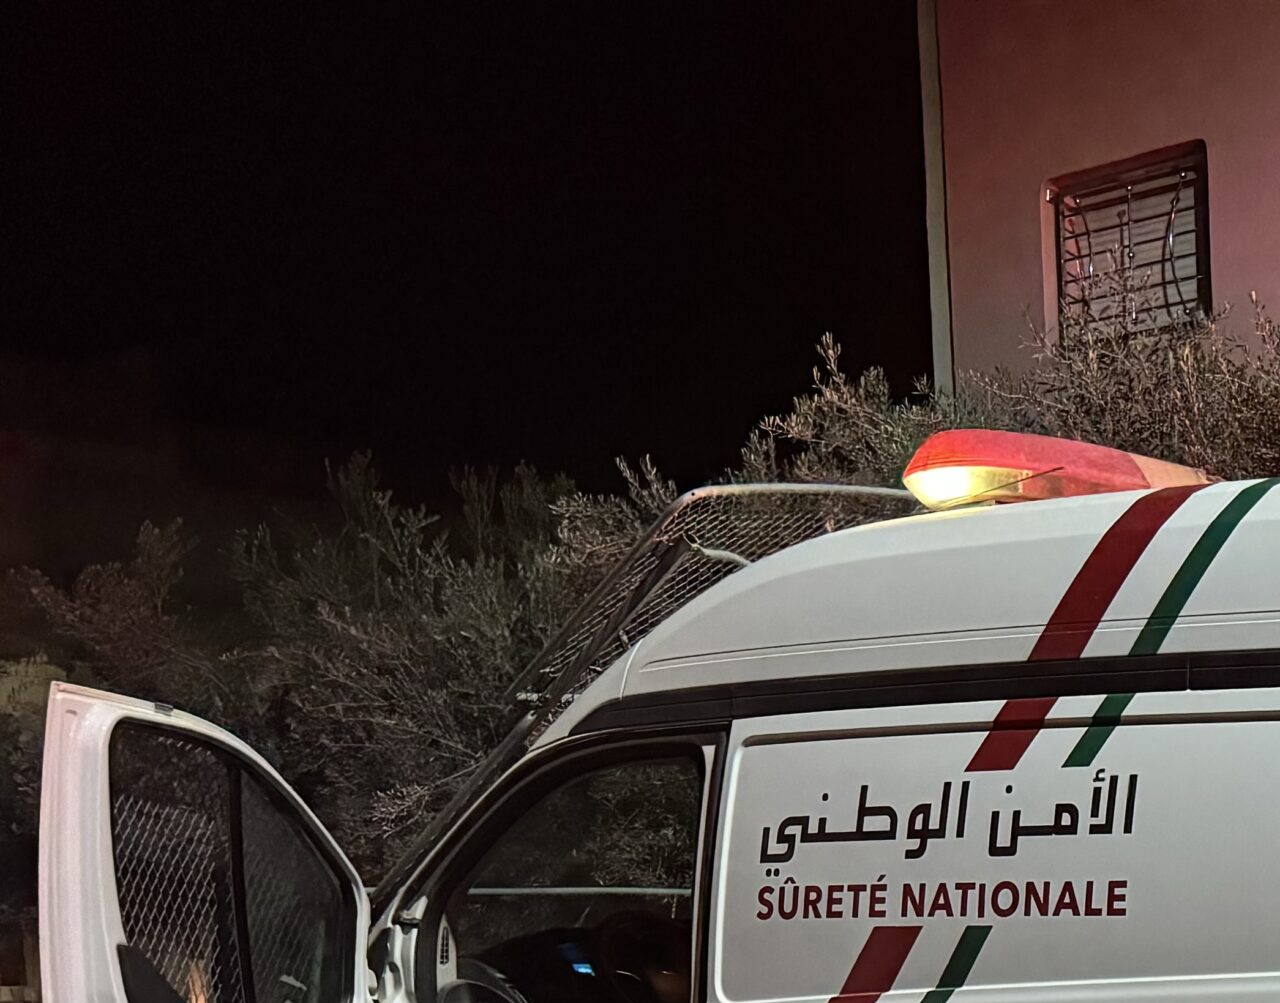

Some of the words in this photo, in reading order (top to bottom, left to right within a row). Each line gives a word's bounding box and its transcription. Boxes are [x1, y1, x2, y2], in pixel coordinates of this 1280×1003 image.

[760, 780, 970, 878] الوطني
[988, 768, 1138, 857] الأمن
[756, 874, 887, 921] SÛRETÉ
[901, 880, 1128, 918] NATIONALE
